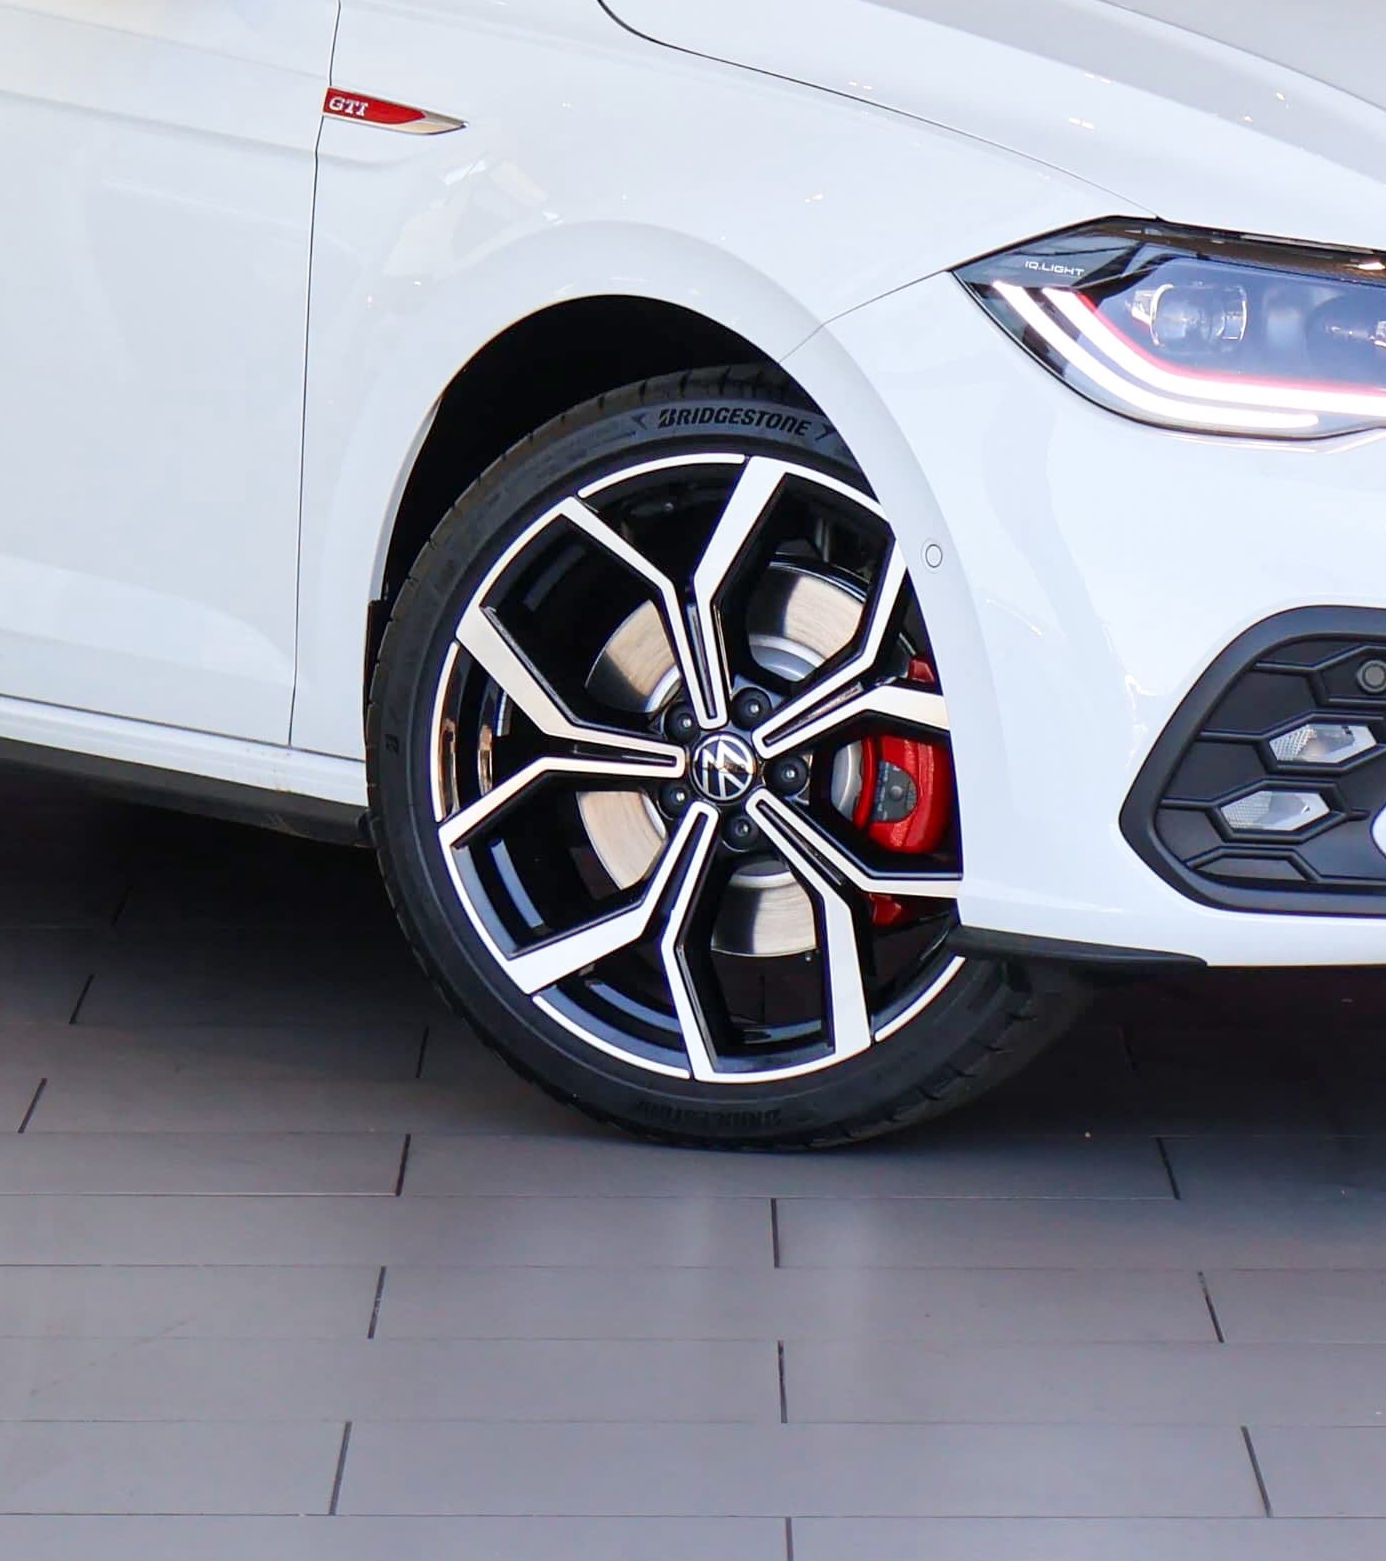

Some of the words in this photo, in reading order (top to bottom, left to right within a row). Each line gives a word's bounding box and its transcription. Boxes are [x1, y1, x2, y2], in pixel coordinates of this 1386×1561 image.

[328, 96, 369, 117] GTI
[1024, 261, 1085, 277] IQ.LIGHT
[658, 406, 813, 437] BRIDGESTONE
